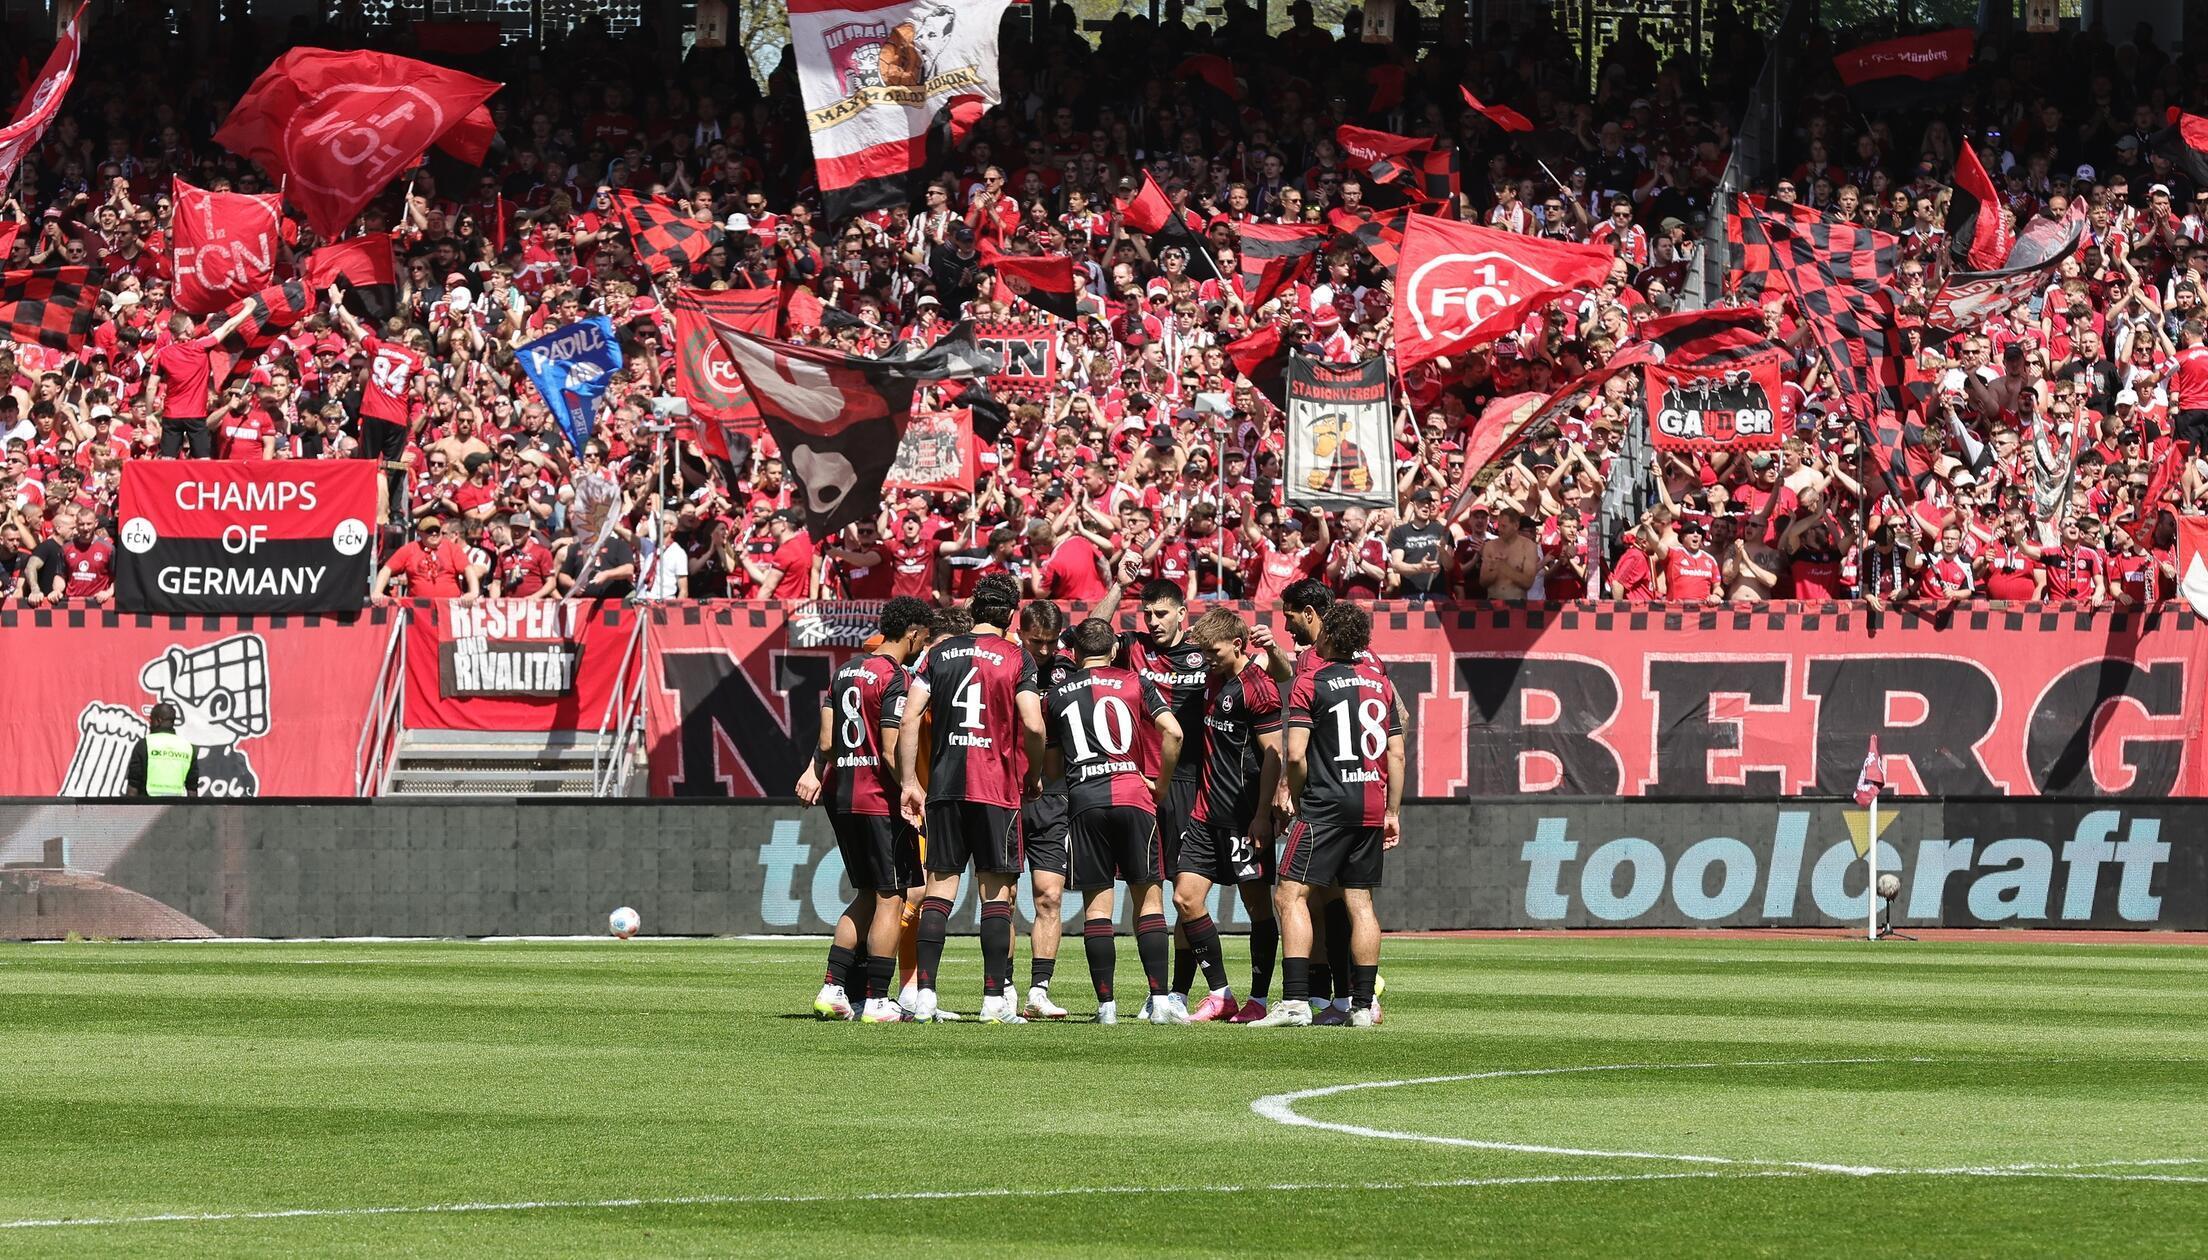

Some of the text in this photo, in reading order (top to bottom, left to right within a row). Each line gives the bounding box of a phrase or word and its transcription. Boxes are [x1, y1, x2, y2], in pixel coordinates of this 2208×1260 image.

[173, 232, 272, 297] FCN
[1473, 264, 1510, 286] 1.
[1430, 286, 1522, 323] FC
[371, 356, 409, 398] 94
[711, 360, 742, 380] FC
[1291, 380, 1386, 401] STADIONVERBOT
[175, 481, 317, 511] CHAMPS
[126, 532, 151, 545] FCN
[222, 524, 268, 554] OF
[338, 533, 363, 545] FCN
[157, 565, 327, 595] GERMANY
[796, 600, 882, 616] DURCHHALTE
[453, 645, 575, 691] RIVALITÄT
[941, 646, 1004, 666] Nürnberg
[838, 667, 878, 685] Nürnberg
[1058, 675, 1124, 697] Nürnberg
[1140, 667, 1207, 685] toolcraft
[1327, 674, 1383, 694] Nürnberg
[952, 666, 987, 730] 4
[841, 686, 867, 749] 8
[1060, 695, 1133, 763] 10
[1328, 698, 1388, 761] 18
[1079, 760, 1137, 783] Justvan
[1229, 836, 1254, 862] 25
[1520, 810, 2172, 923] toolcraft
